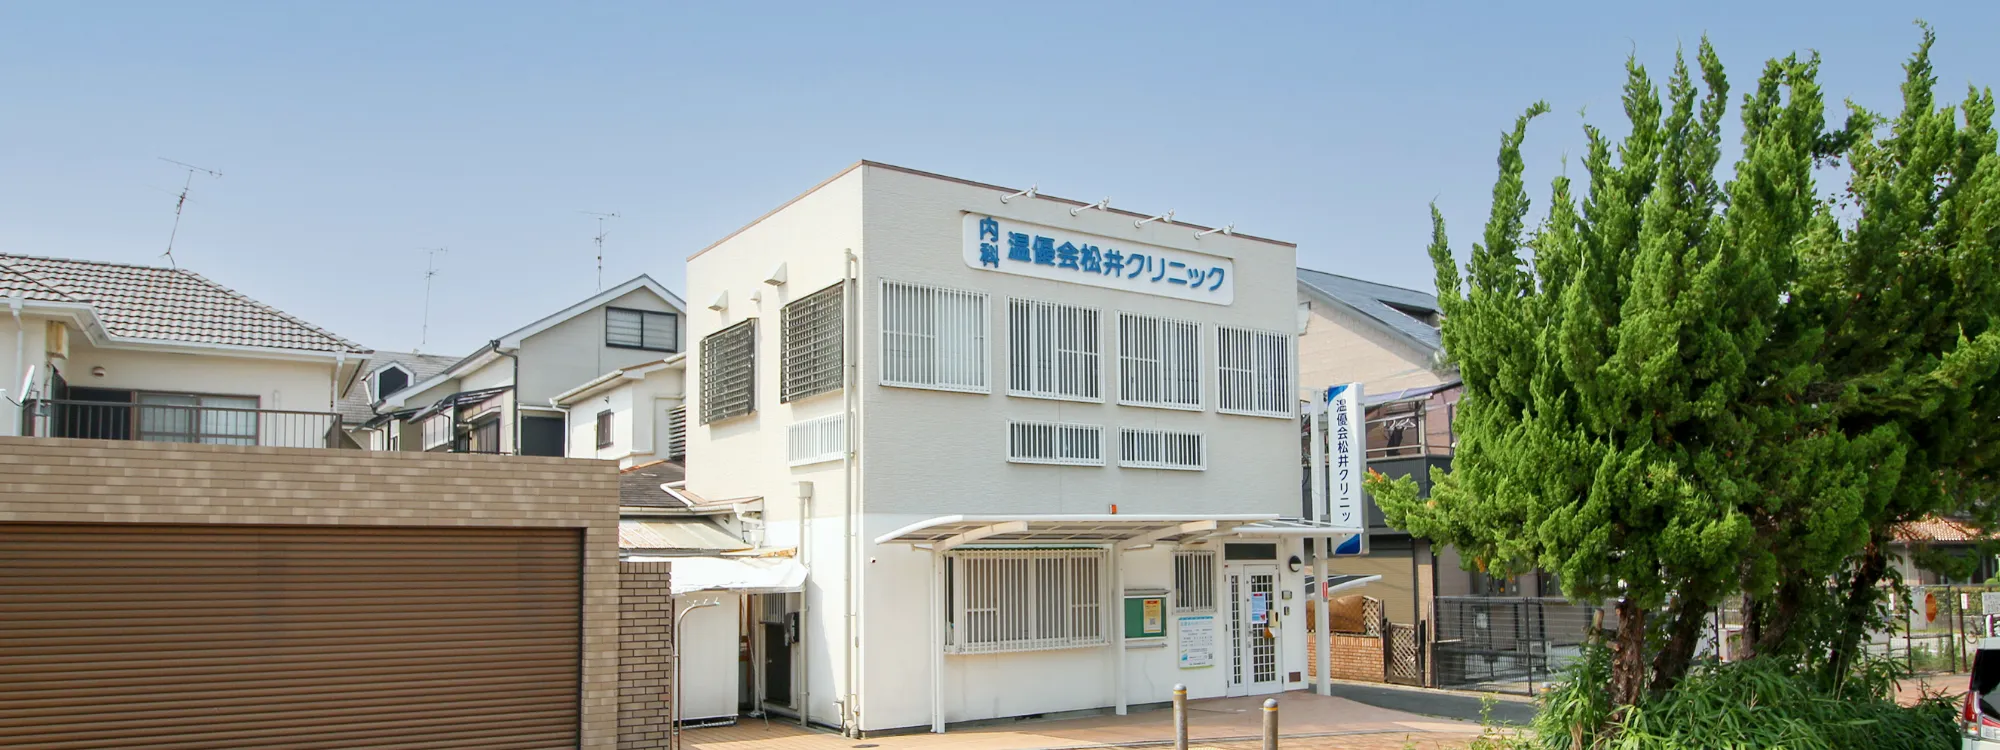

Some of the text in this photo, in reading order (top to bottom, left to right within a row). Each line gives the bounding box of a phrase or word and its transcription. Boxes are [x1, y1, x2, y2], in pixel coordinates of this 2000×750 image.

[979, 216, 999, 268] 内科
[1007, 231, 1225, 291] 温優会松井クリニック
[1336, 399, 1350, 535] 温優会松井クリニッ
